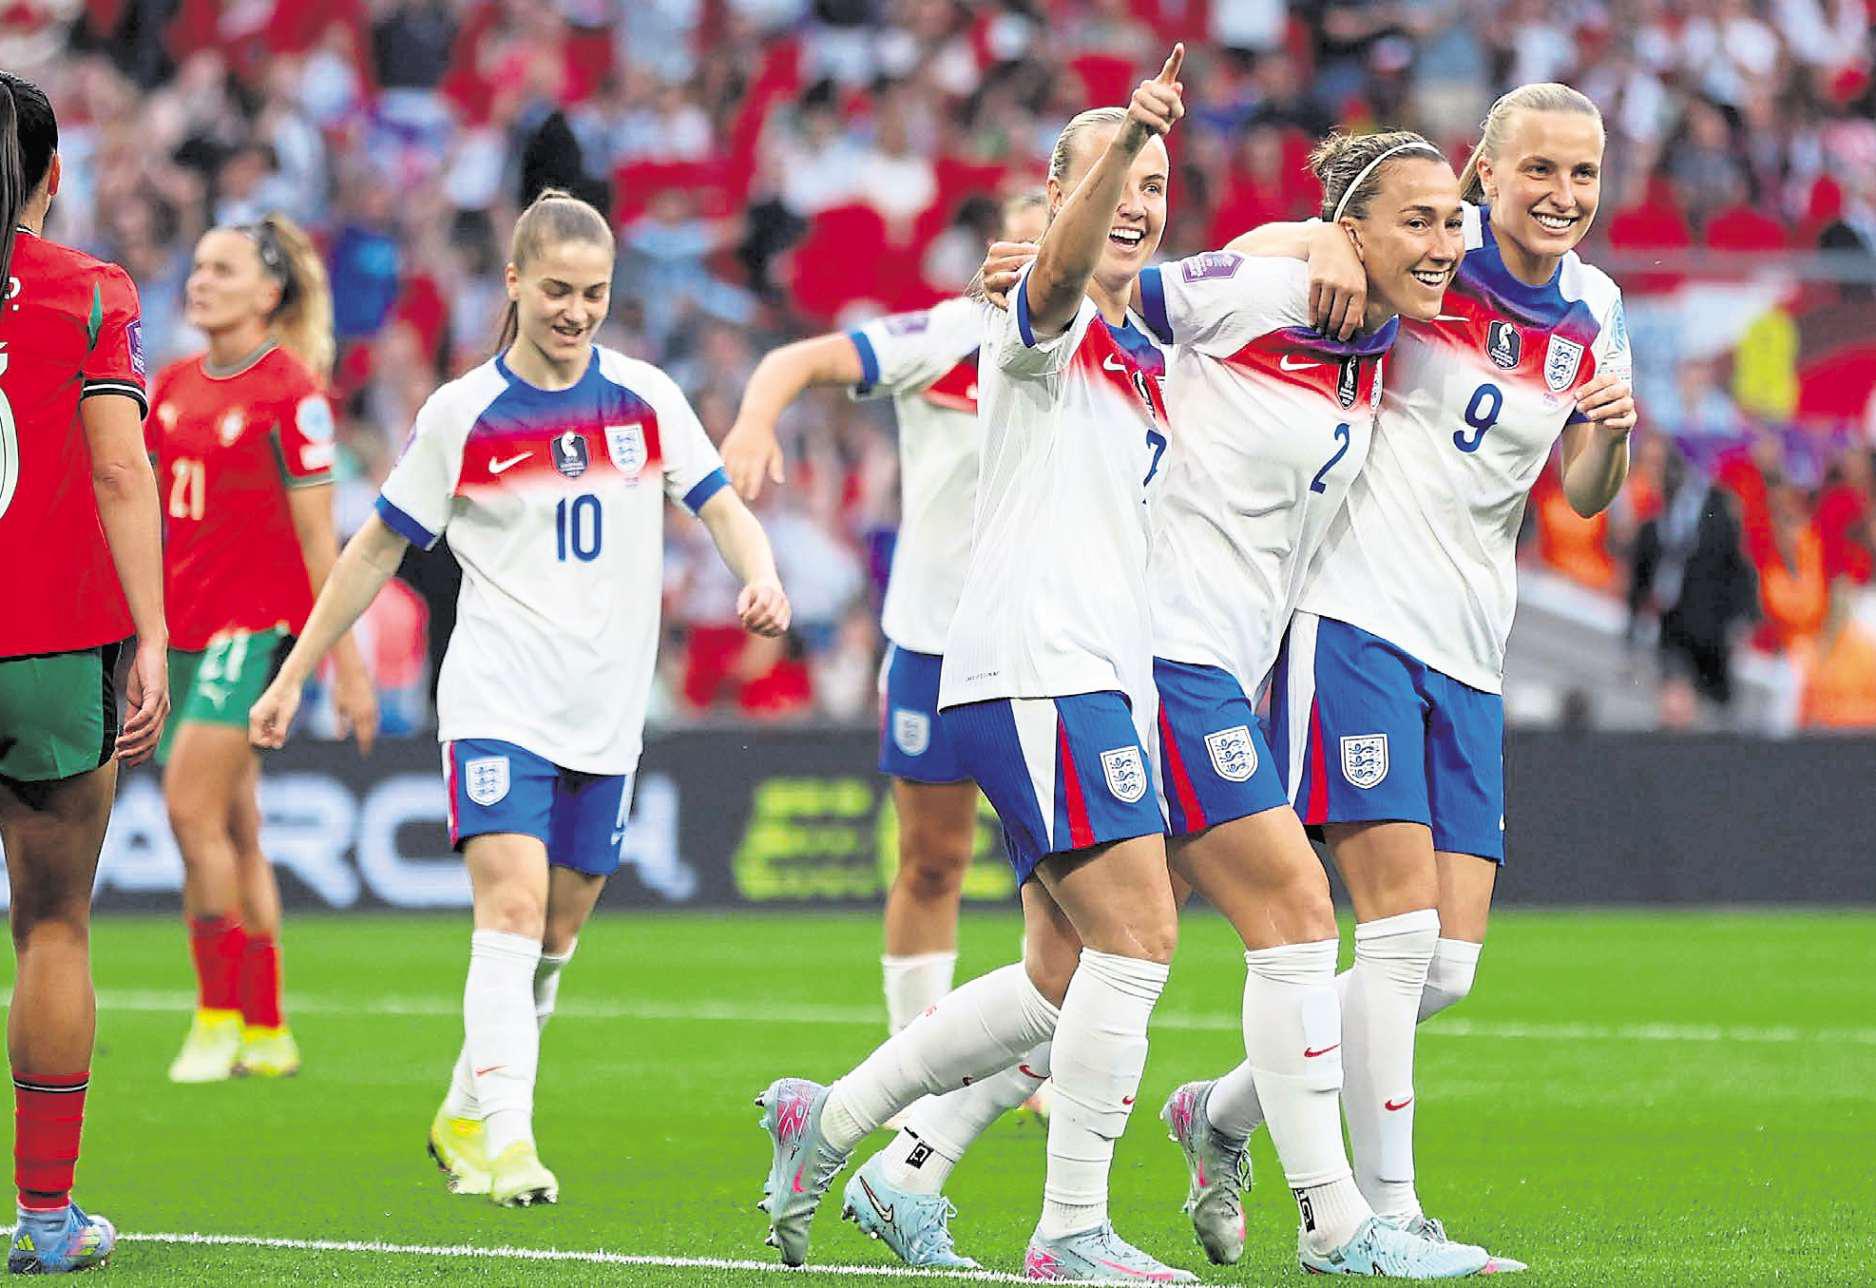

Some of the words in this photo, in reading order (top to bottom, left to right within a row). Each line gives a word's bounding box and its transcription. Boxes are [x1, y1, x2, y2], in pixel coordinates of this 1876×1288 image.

[1453, 383, 1504, 453] 9
[168, 457, 206, 522] 21
[1309, 422, 1351, 494] 2
[556, 493, 602, 563] 10
[0, 773, 697, 908] ARCH
